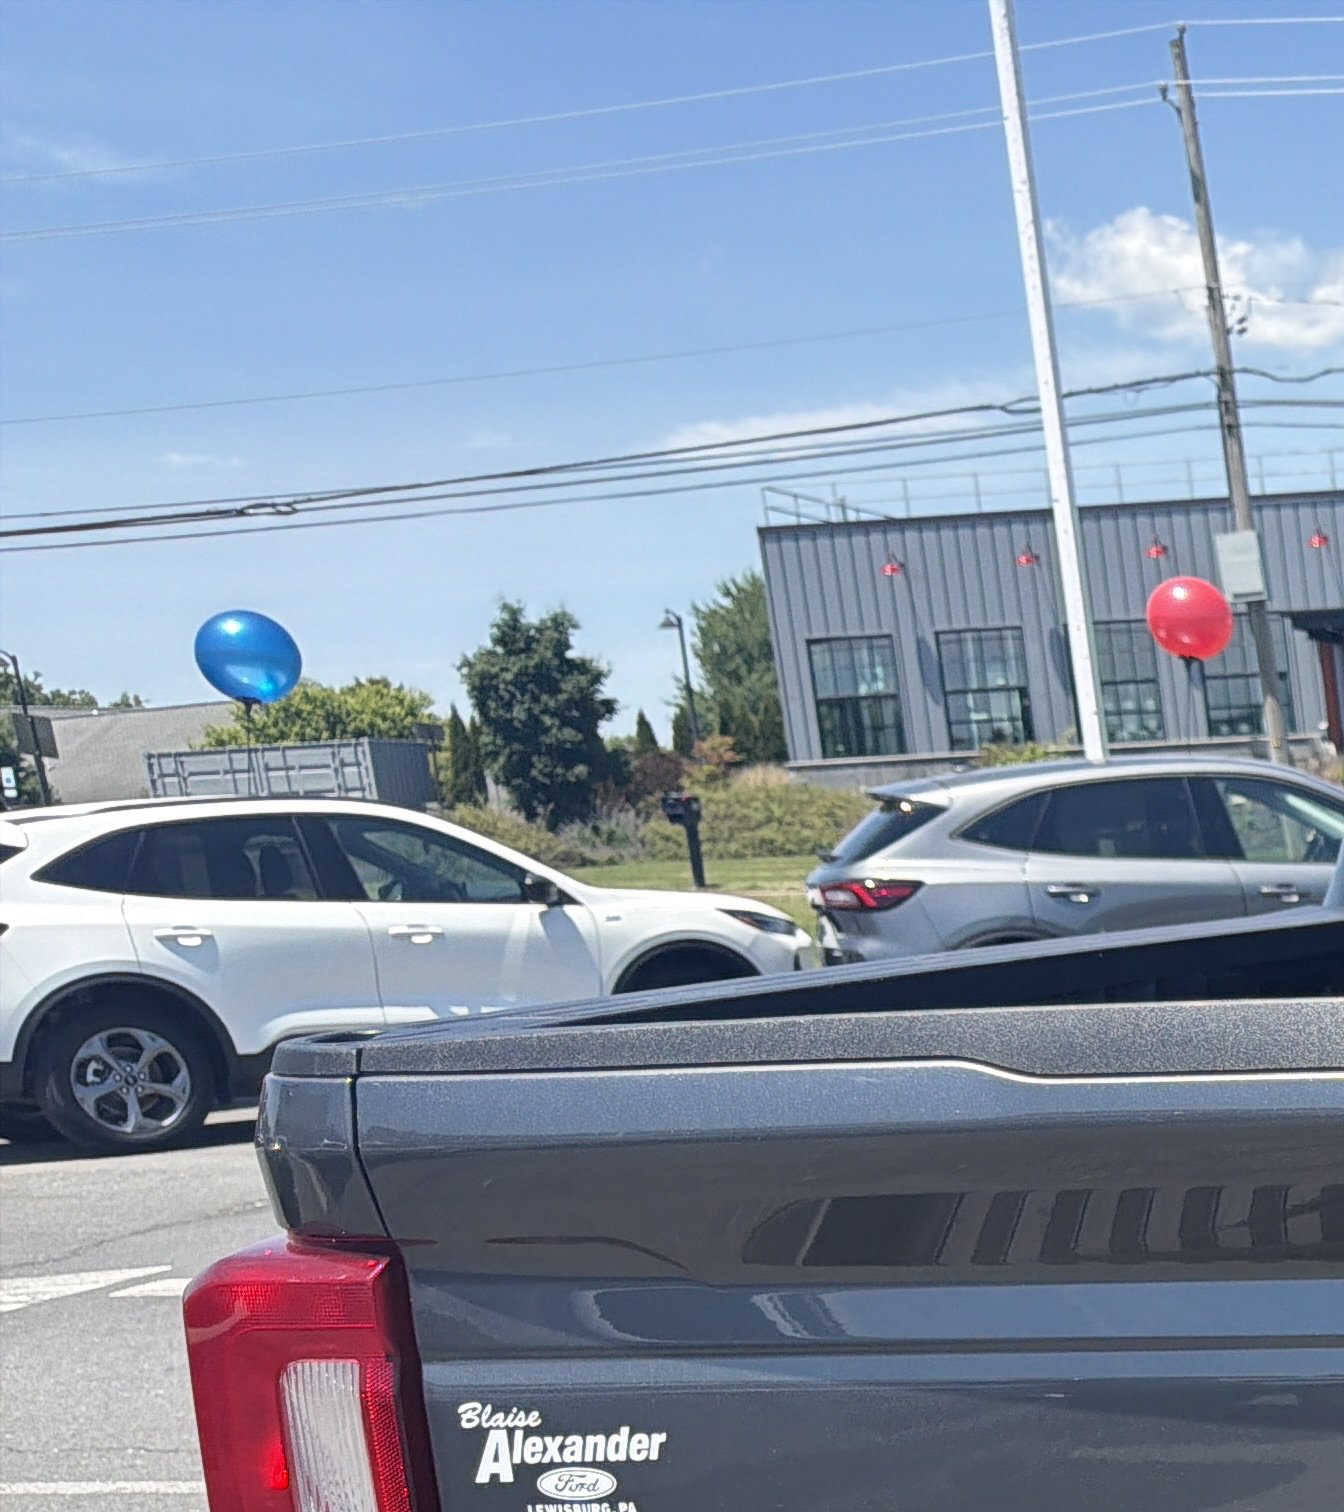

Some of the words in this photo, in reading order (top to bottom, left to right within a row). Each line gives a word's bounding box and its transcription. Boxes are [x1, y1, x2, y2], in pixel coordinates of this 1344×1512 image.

[457, 1401, 542, 1429] Blaise
[475, 1426, 667, 1483] Alexander
[554, 1473, 600, 1494] Ford
